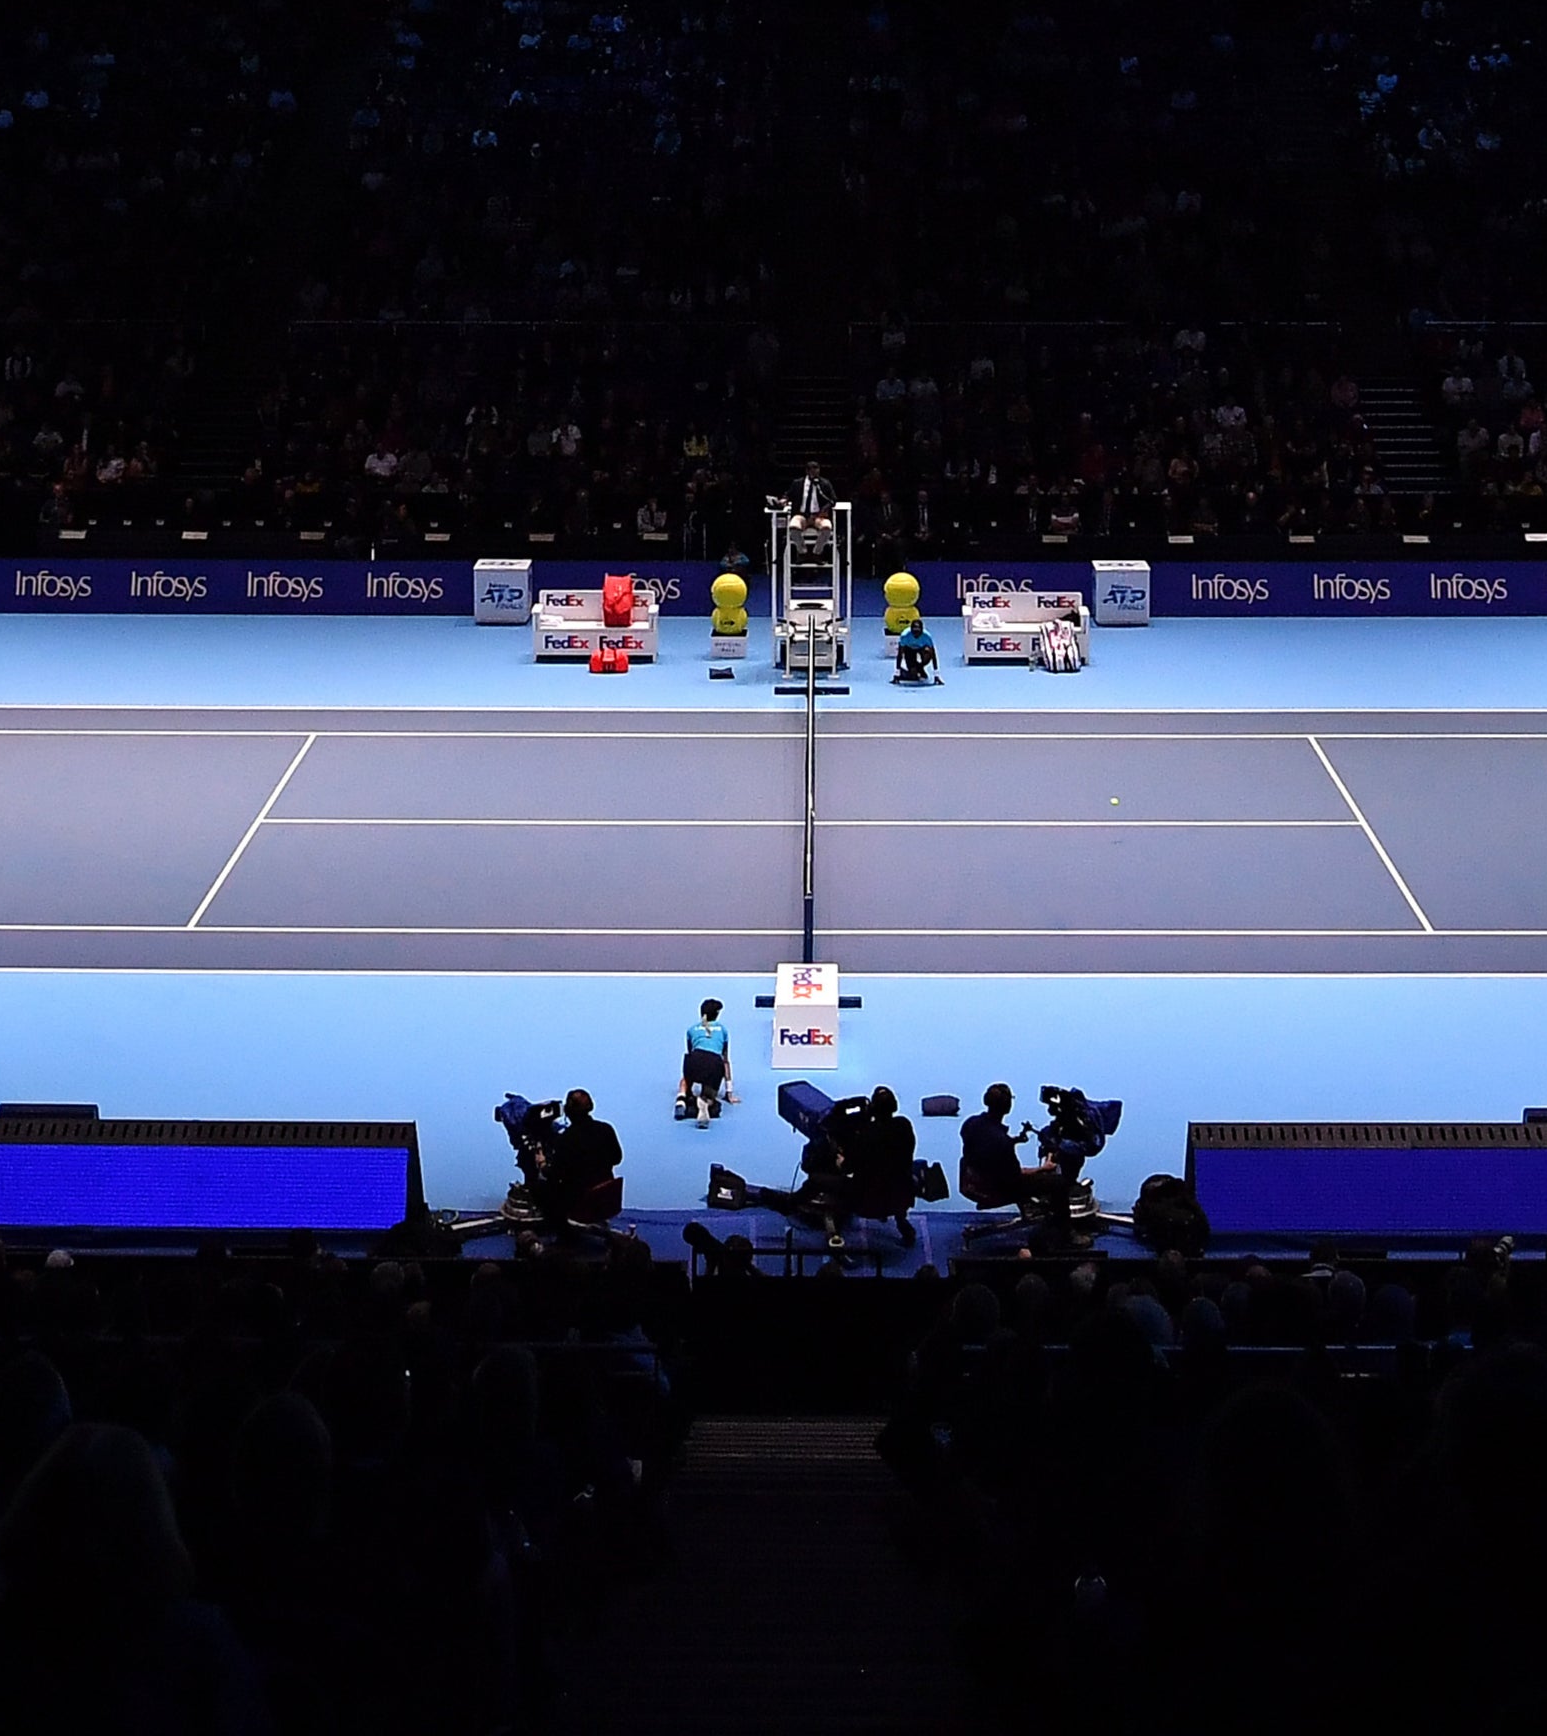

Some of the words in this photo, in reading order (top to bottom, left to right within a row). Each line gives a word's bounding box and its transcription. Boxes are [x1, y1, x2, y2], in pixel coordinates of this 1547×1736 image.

[15, 570, 92, 601] Infosys
[130, 570, 207, 602] Infosys
[247, 571, 323, 603] Infosys
[366, 572, 444, 603] Infosys
[1192, 573, 1269, 605] Infosys
[1313, 573, 1391, 604] Infosys
[1430, 573, 1508, 604] Infosys
[480, 587, 524, 604] ATP
[546, 594, 585, 608] FedEx
[972, 596, 1011, 609] FedEx
[1037, 596, 1076, 609] FedEx
[1103, 589, 1147, 604] ATP
[544, 635, 590, 650] FedEx
[598, 635, 644, 651] FedEx
[976, 637, 1022, 652] FedEx
[779, 1028, 834, 1045] FedEx
